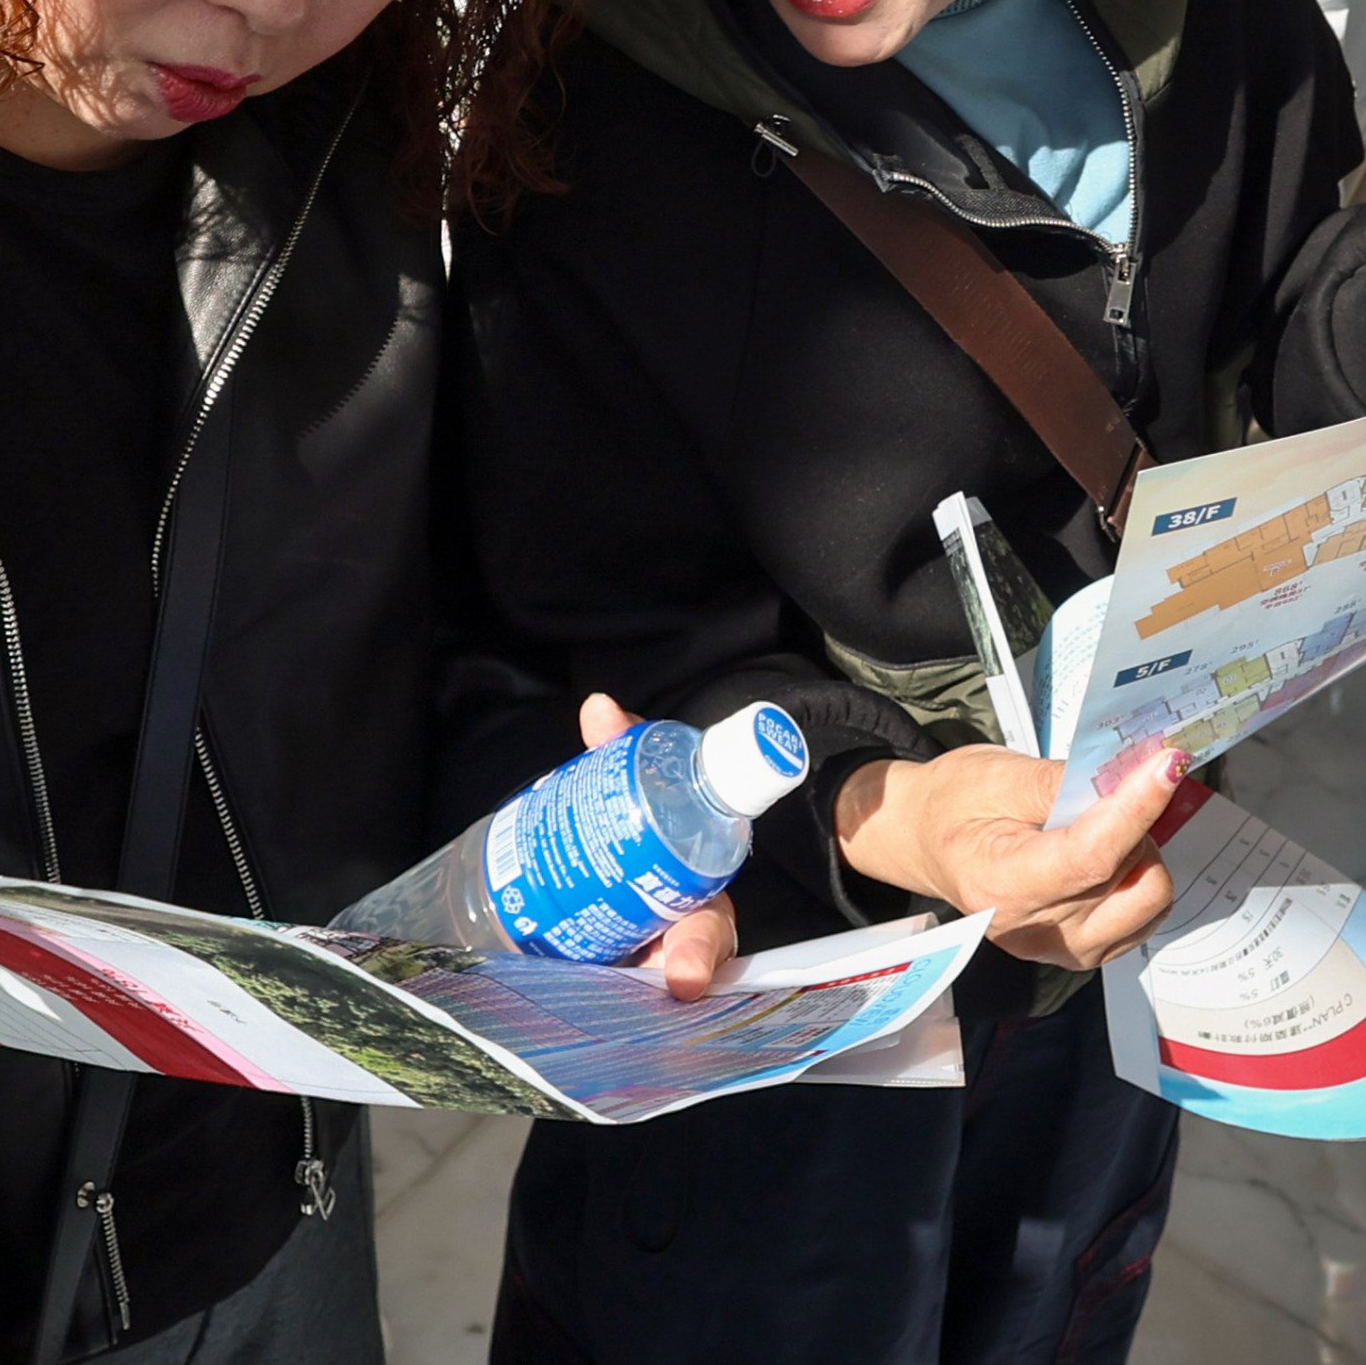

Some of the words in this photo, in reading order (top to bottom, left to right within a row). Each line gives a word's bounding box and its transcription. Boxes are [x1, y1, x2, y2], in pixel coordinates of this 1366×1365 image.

[1168, 505, 1222, 529] 38/F
[1135, 659, 1172, 679] 5/F
[758, 712, 803, 750] POCARI
[758, 721, 798, 754] SWEAT
